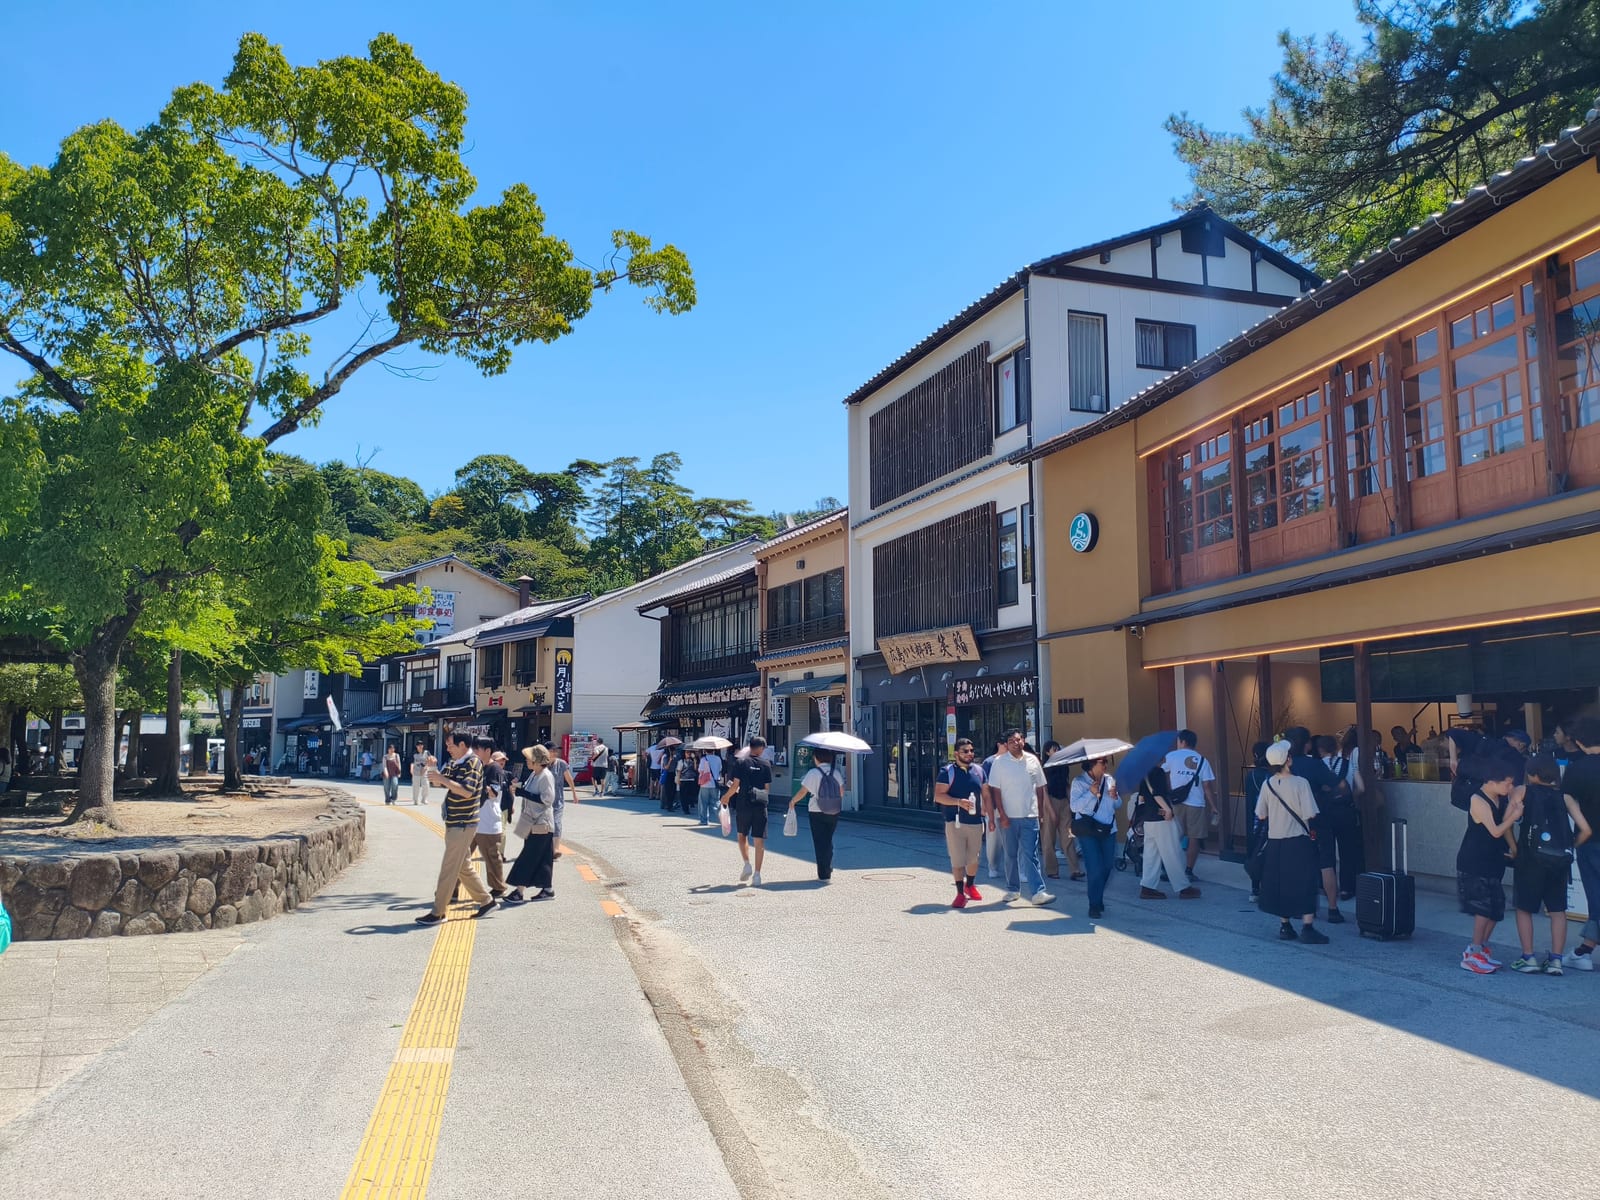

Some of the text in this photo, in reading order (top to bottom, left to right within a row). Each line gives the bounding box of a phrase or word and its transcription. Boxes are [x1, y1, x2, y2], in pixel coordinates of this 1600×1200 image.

[417, 607, 453, 617] 御食事処
[556, 667, 566, 712] 月うさぎ
